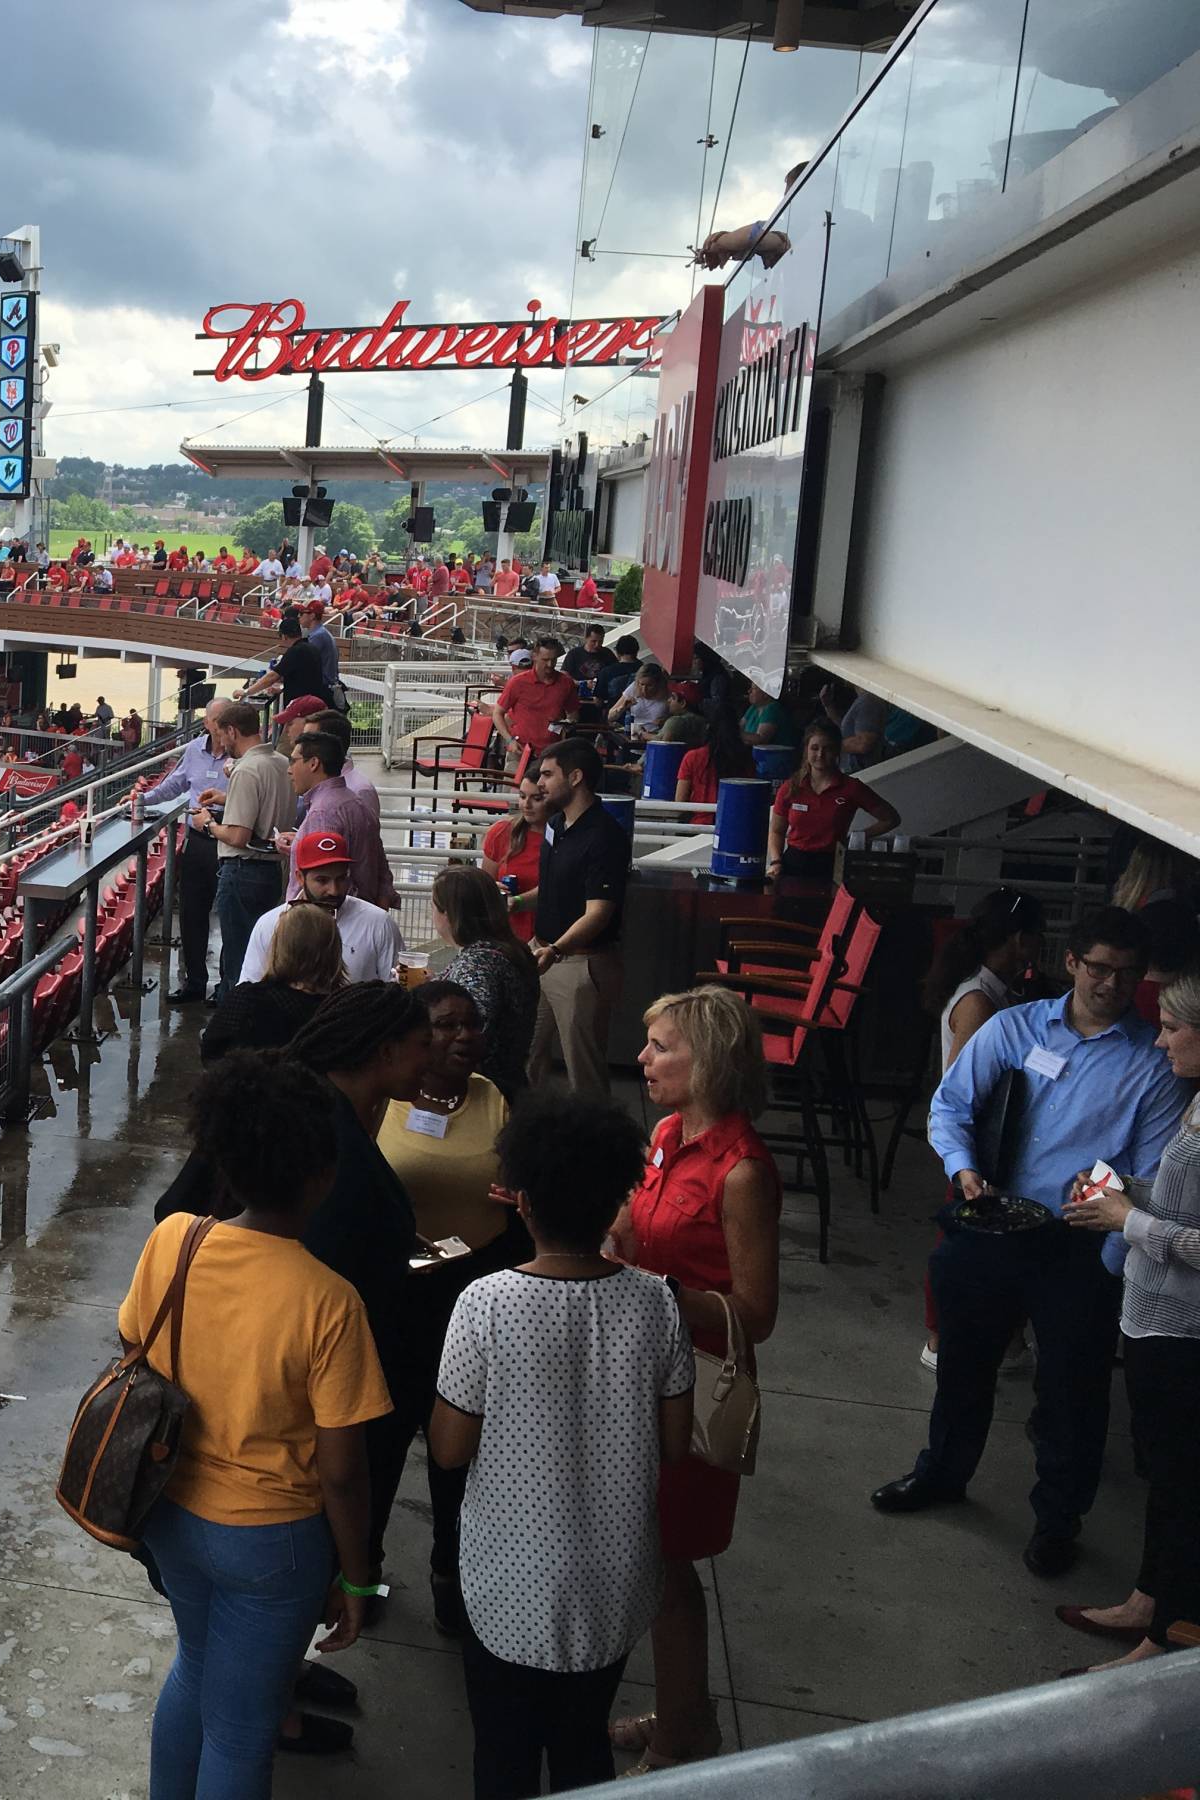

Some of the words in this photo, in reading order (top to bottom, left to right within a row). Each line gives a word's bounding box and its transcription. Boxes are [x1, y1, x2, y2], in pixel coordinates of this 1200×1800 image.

[203, 299, 664, 382] Budweiser
[713, 322, 808, 462] CINCINNATI
[703, 496, 752, 587] CASINO
[9, 774, 48, 790] Budweiser
